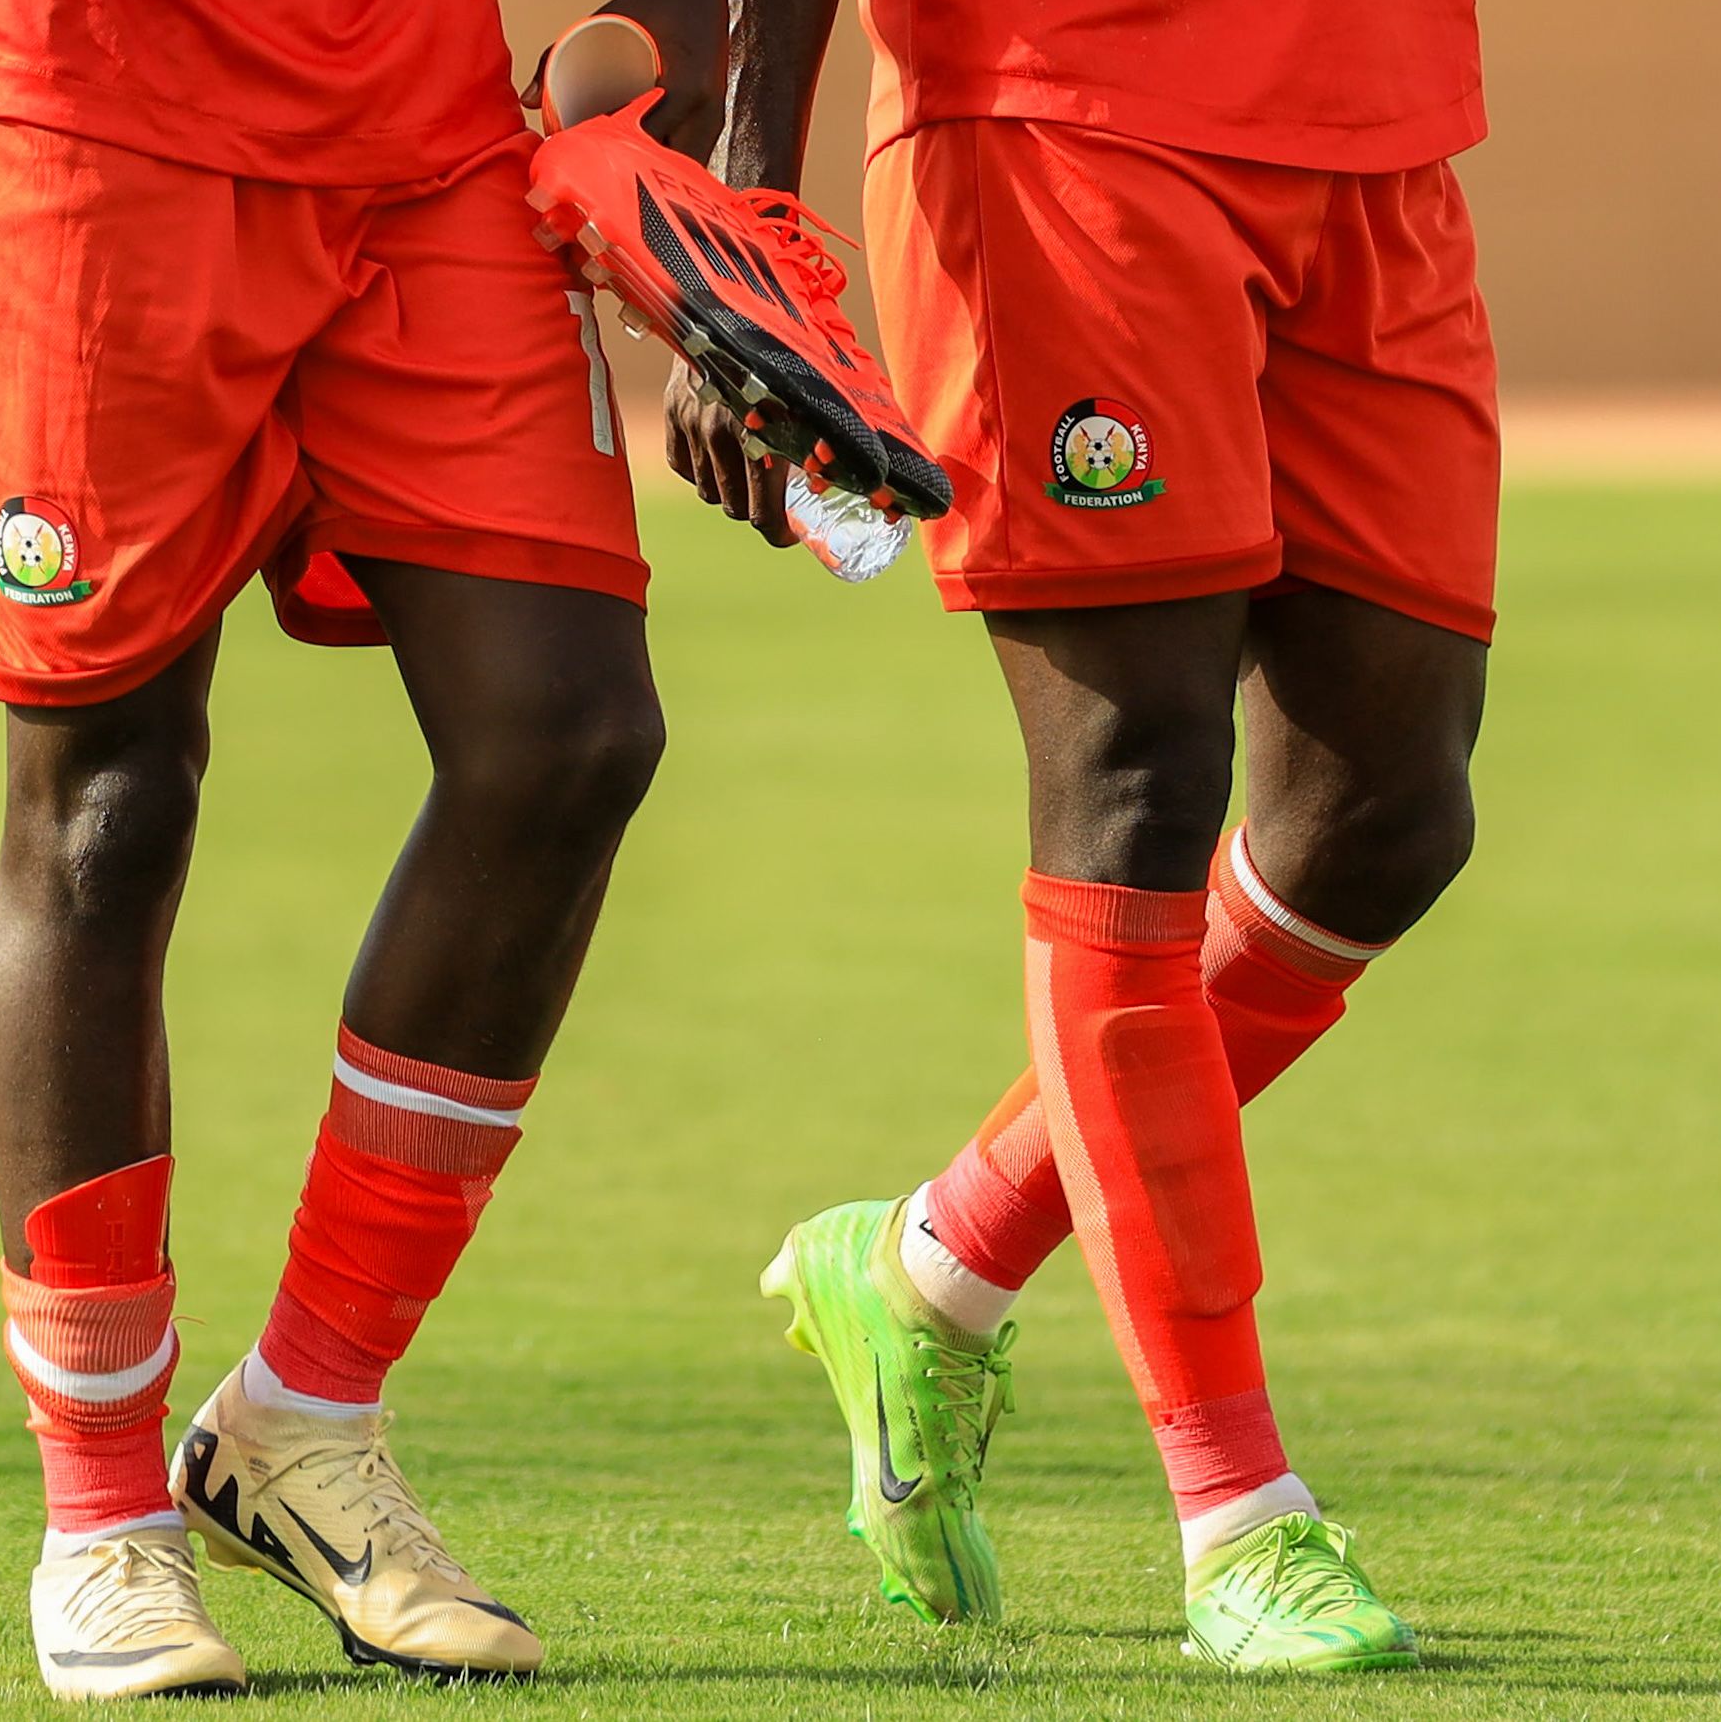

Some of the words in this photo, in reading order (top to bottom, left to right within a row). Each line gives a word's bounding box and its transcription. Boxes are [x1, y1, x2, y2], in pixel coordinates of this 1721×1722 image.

[652, 169, 753, 237] F50
[1054, 414, 1076, 483] FOOTBALL
[1130, 423, 1150, 471] KENYA
[1064, 491, 1144, 507] FEDERATION
[58, 523, 76, 571] KENYA
[4, 587, 74, 604] FEDERATION
